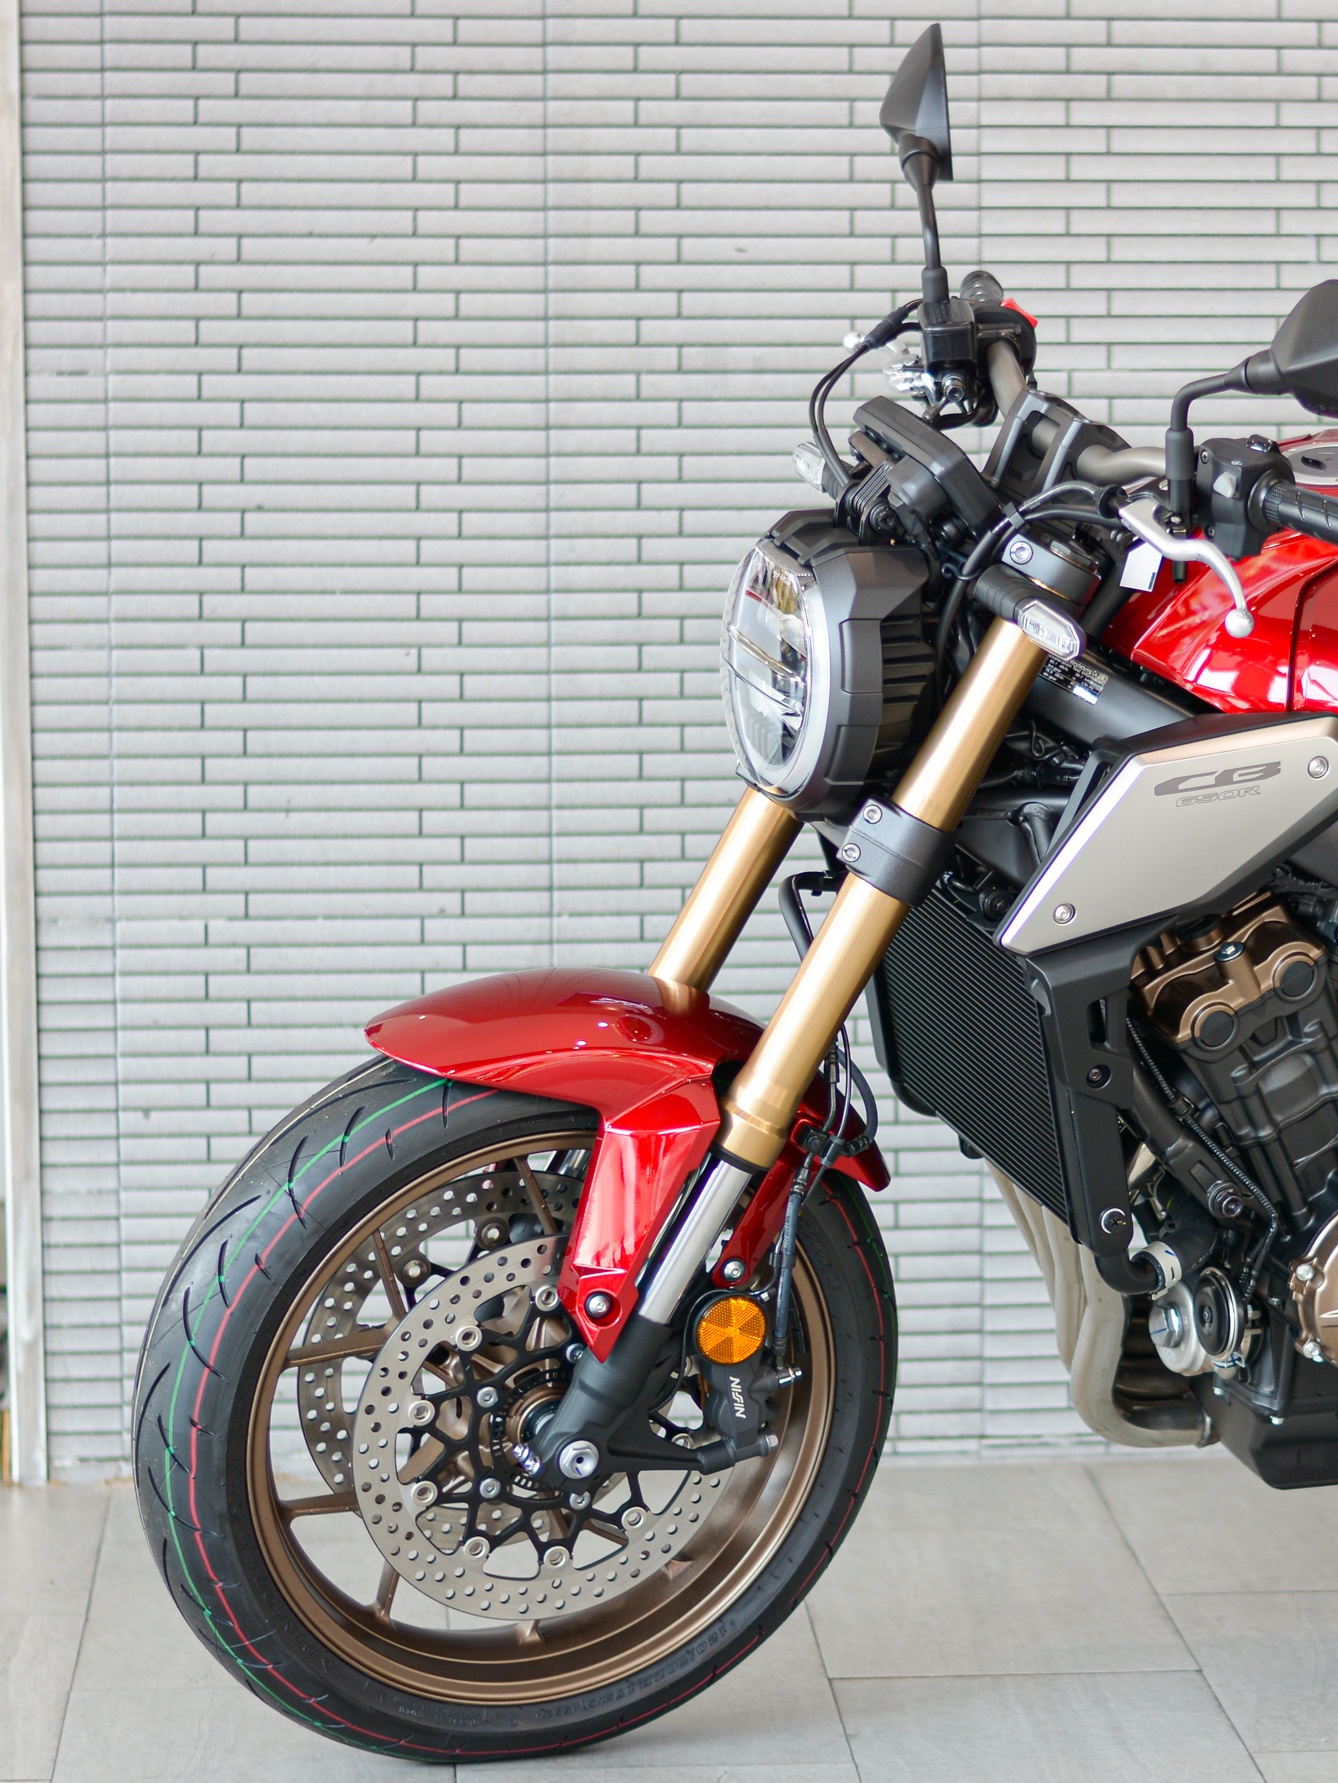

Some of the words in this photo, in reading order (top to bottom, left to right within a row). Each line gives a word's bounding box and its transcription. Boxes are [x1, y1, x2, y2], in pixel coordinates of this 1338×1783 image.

[1154, 761, 1281, 796] CB
[1176, 786, 1261, 807] 650R
[729, 1375, 747, 1419] NISSIN
